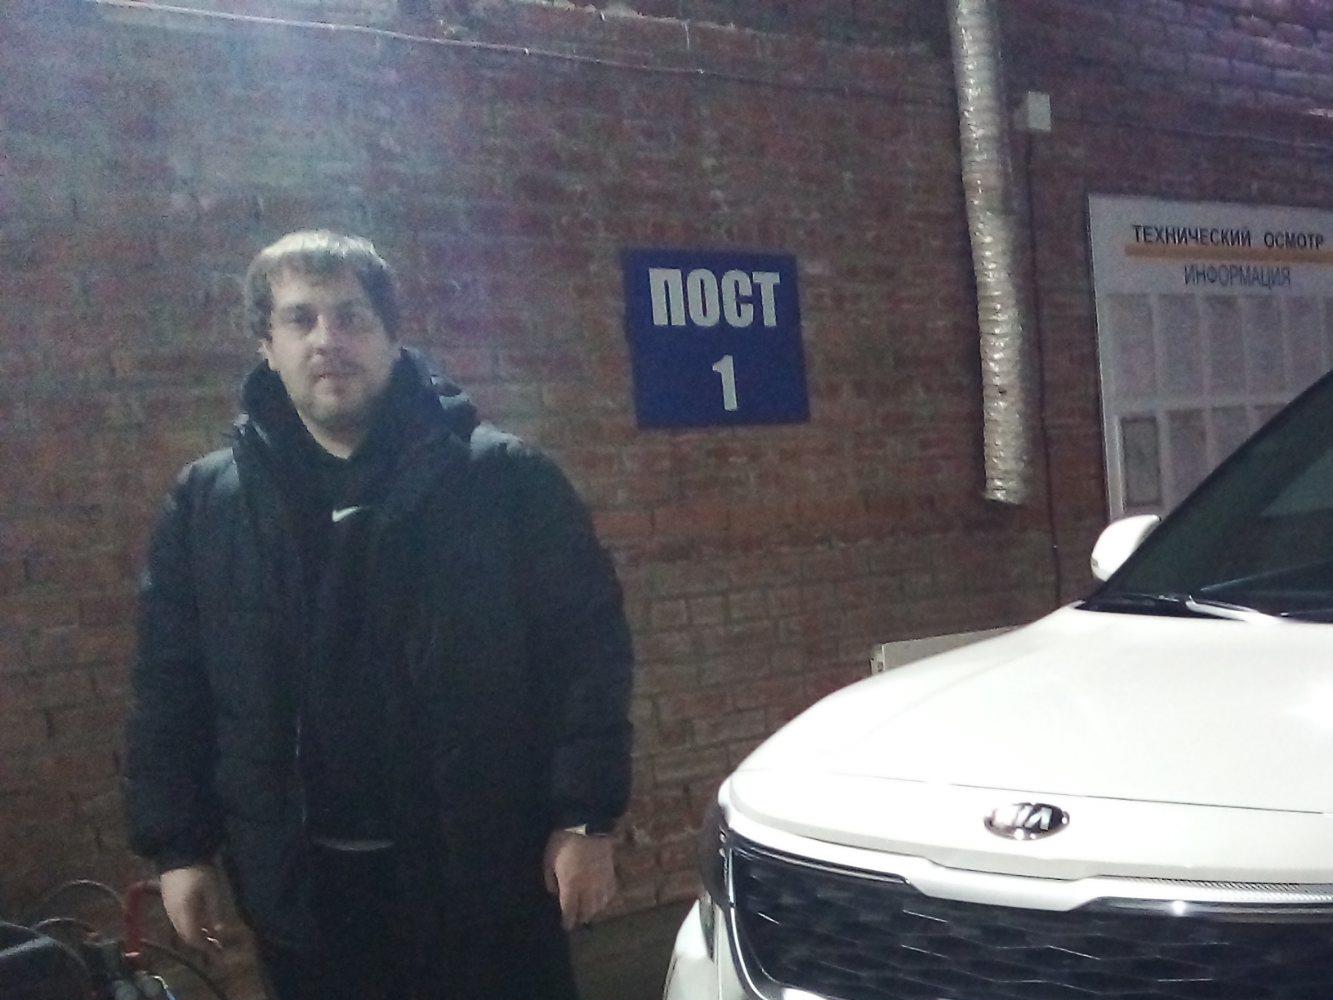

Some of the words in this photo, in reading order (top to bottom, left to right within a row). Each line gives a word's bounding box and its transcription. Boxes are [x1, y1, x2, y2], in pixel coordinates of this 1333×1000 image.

[1133, 224, 1252, 247] ТЕХНИЧЕСКИЙ
[1264, 231, 1326, 251] ОСМОТР
[649, 267, 780, 328] ПОСТ
[1184, 263, 1292, 290] ИНФОРМАЦИЯ
[712, 354, 738, 412] 1
